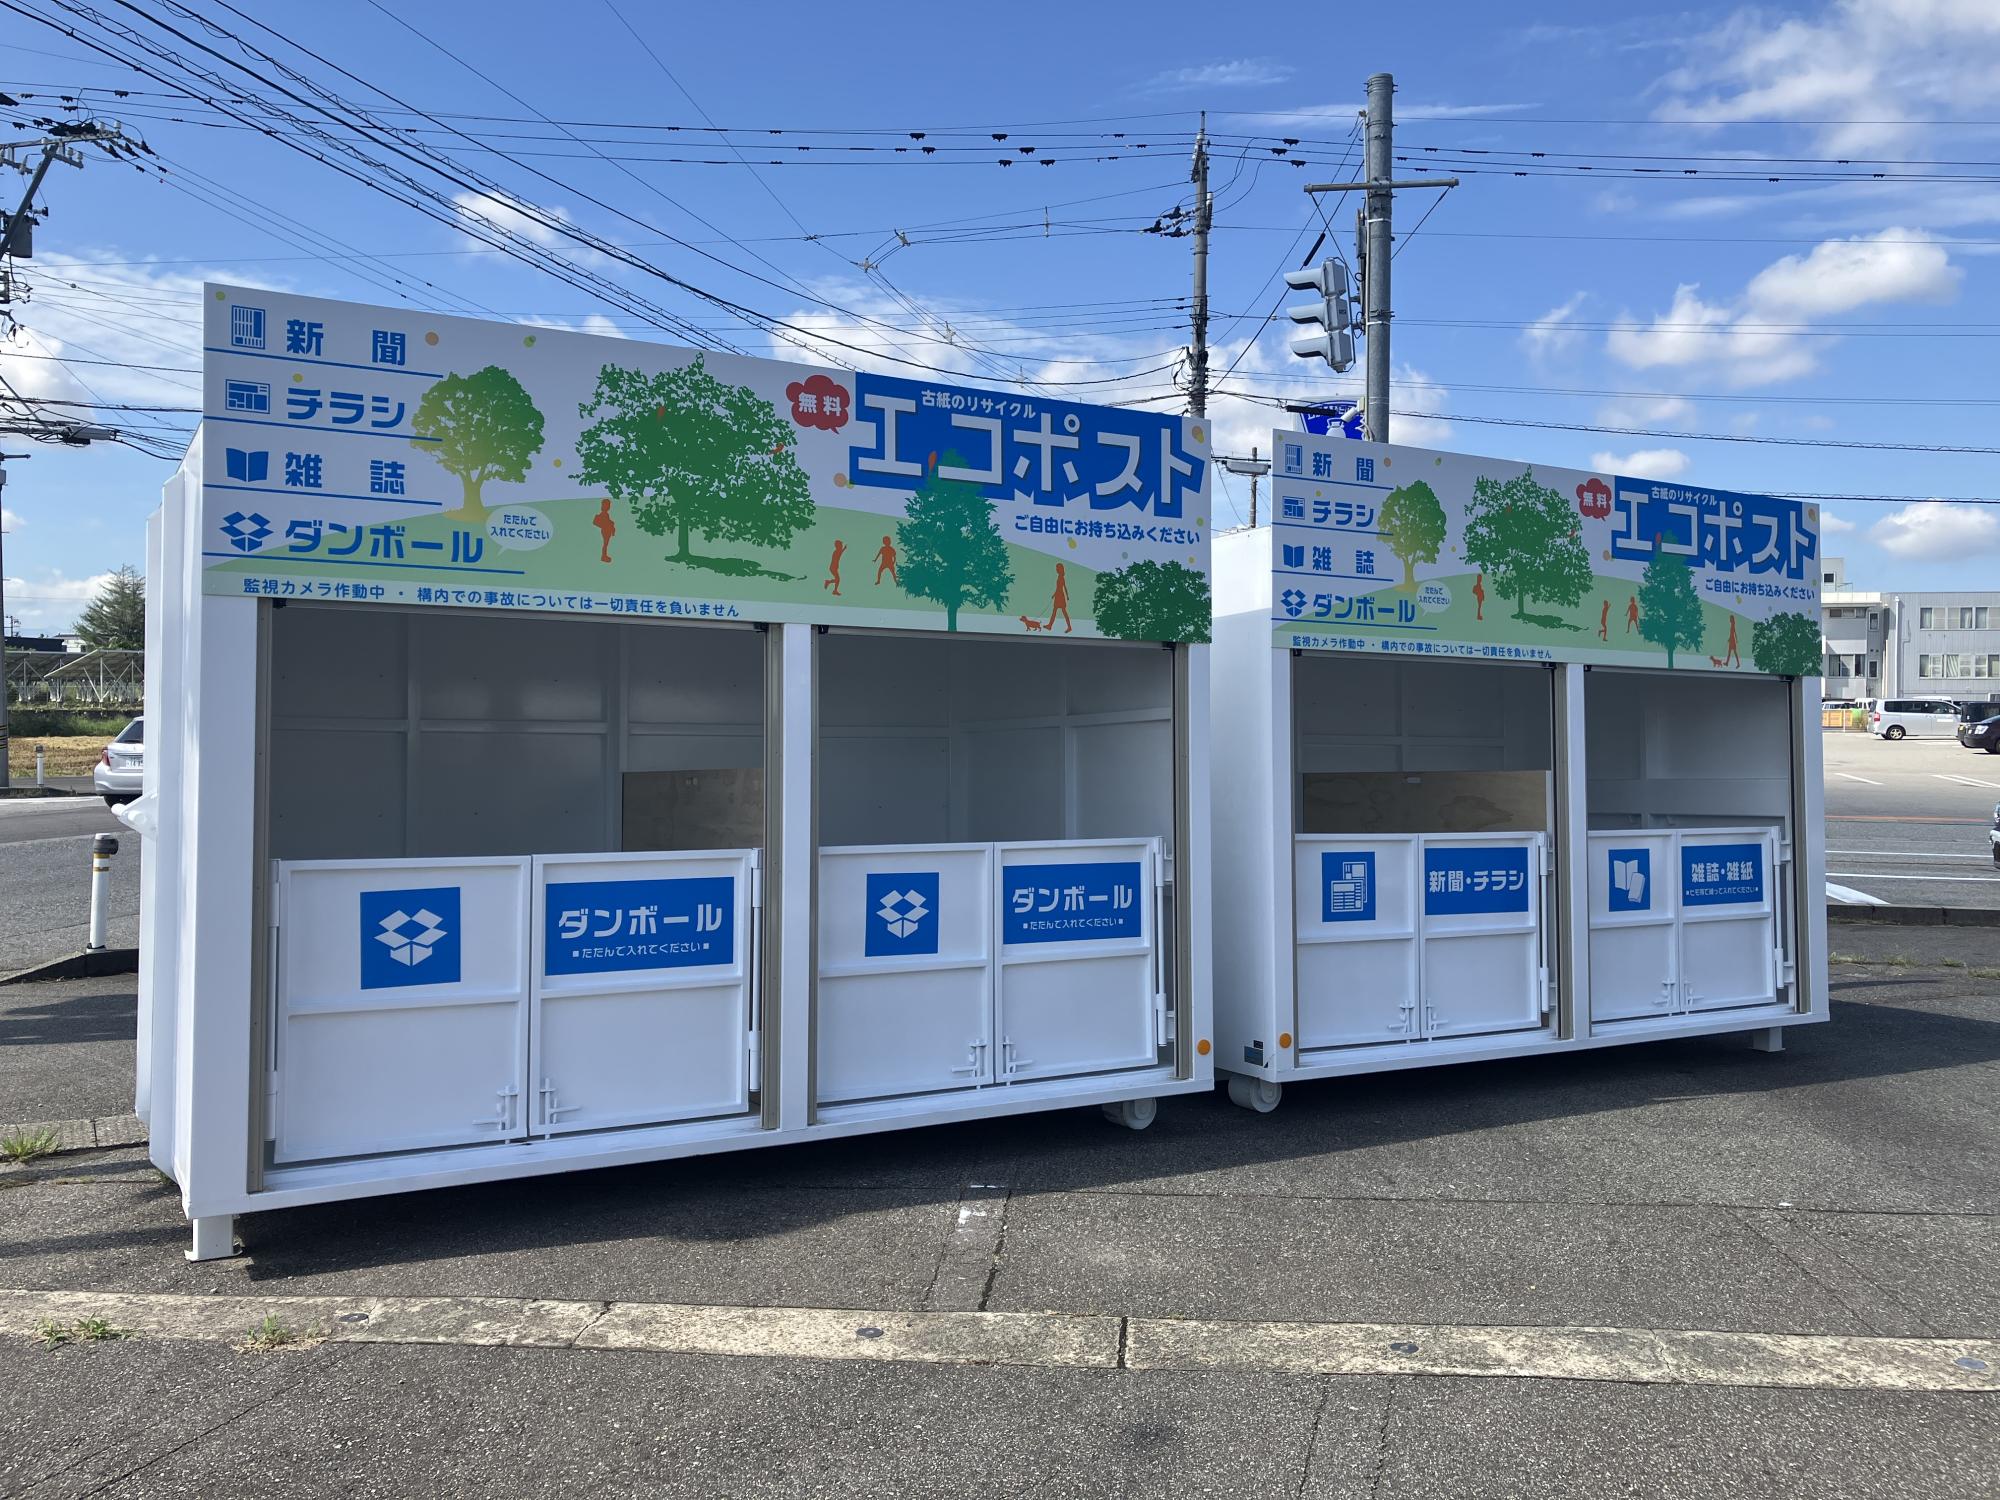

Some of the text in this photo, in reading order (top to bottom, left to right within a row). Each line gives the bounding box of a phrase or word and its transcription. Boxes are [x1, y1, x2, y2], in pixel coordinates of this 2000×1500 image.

[286, 319, 407, 366] 新聞
[286, 387, 406, 428] チラシ
[798, 391, 842, 417] 無料
[921, 389, 1036, 419] 古紙のリサイクル
[858, 393, 1193, 504] エコポスト
[285, 452, 406, 496] 雑誌
[1312, 452, 1375, 483] 新聞
[1583, 491, 1609, 509] 無料
[1651, 486, 1718, 507] 古紙のリサイクル
[1312, 500, 1375, 528] チラシ
[285, 519, 484, 565] ダンボール
[490, 526, 550, 540] 入れてください
[1014, 514, 1201, 546] ご自由にお持ち込みください
[1616, 490, 1809, 569] エコポスト
[1312, 545, 1375, 575] 雑誌
[1705, 578, 1815, 601] ご自由にお持ち込みください
[1313, 593, 1416, 623] ダンボール
[1429, 869, 1525, 893] 新聞・チラシ
[1012, 884, 1133, 914] ダンボール
[558, 902, 723, 940] ダンボール
